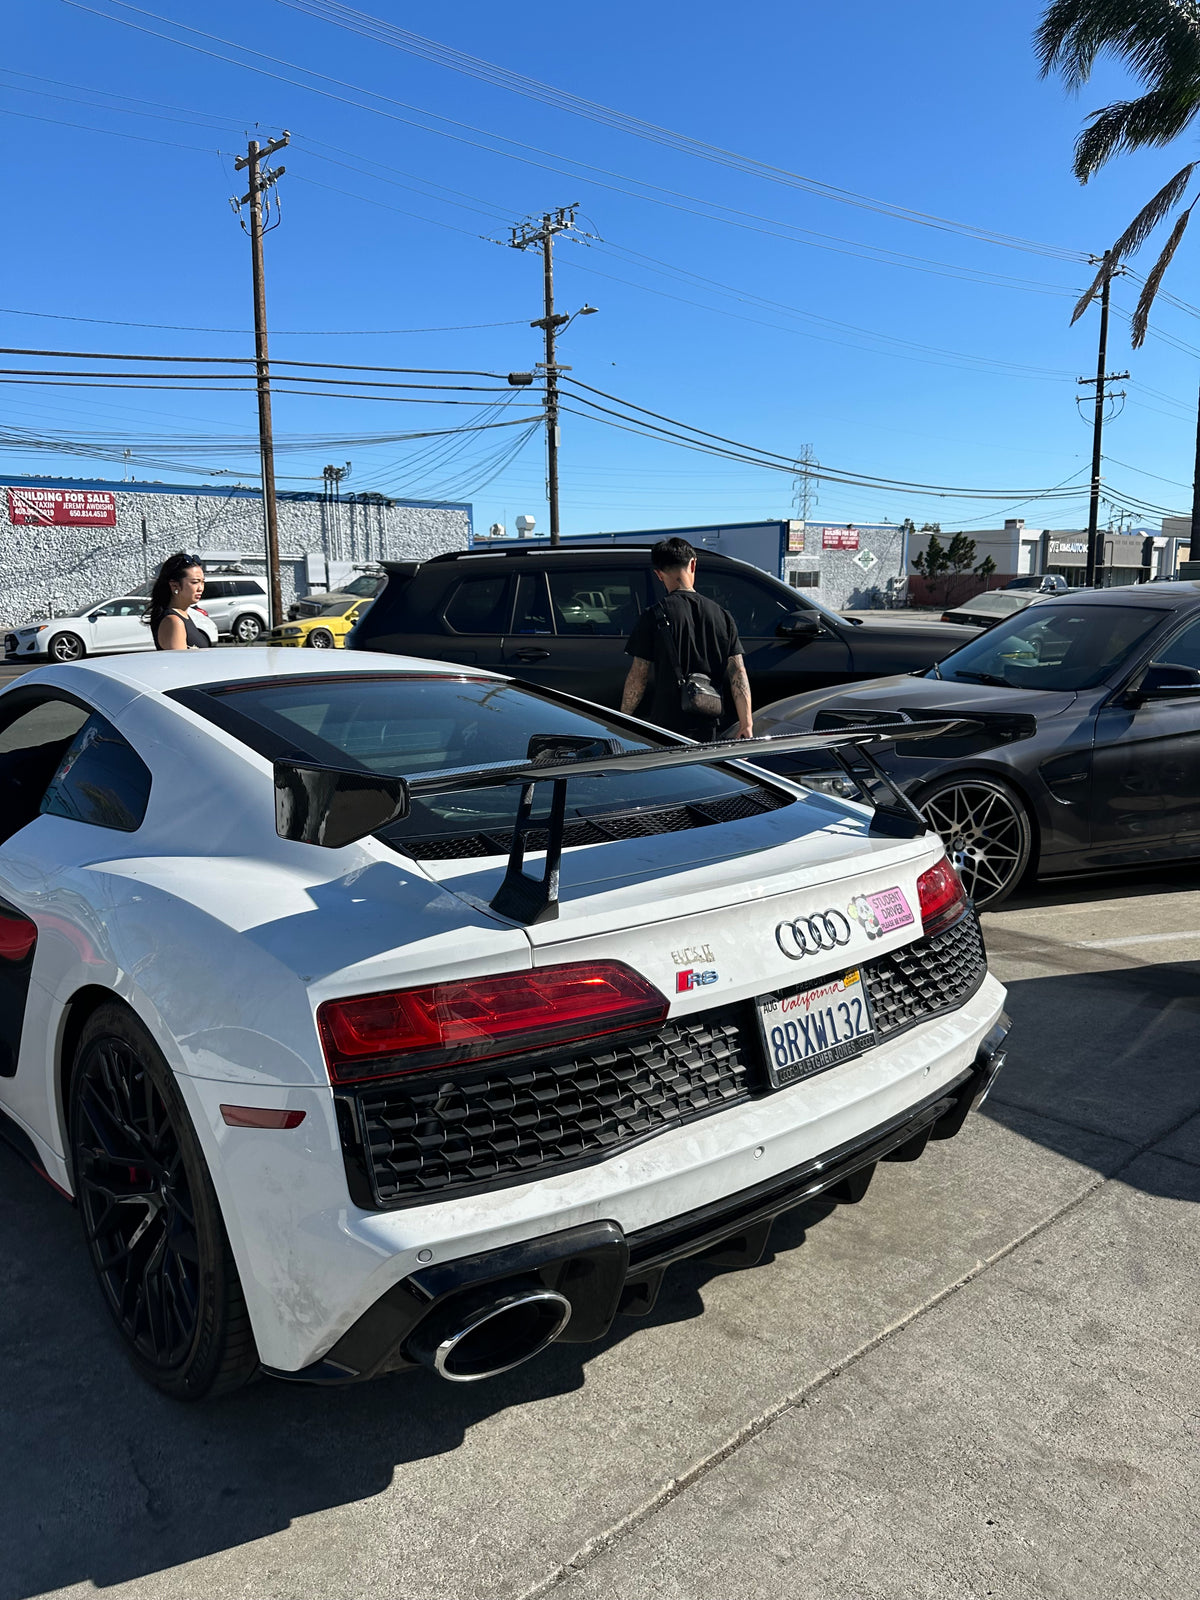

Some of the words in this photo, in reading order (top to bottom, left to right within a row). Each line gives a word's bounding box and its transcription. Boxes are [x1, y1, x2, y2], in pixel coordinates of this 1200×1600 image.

[63, 502, 85, 510] JEREMY
[86, 503, 114, 511] AWDISHO
[64, 493, 85, 503] FOR
[87, 494, 110, 503] SALE
[872, 890, 901, 909] STUDENT
[881, 903, 905, 920] DRIVER
[881, 919, 894, 929] PLEASE
[899, 913, 912, 923] PATIENT
[781, 982, 847, 1013] California
[763, 999, 778, 1015] AUG
[771, 997, 869, 1068] 8RXW132
[799, 1050, 833, 1075] FLETCHER
[834, 1041, 857, 1060] JONES
